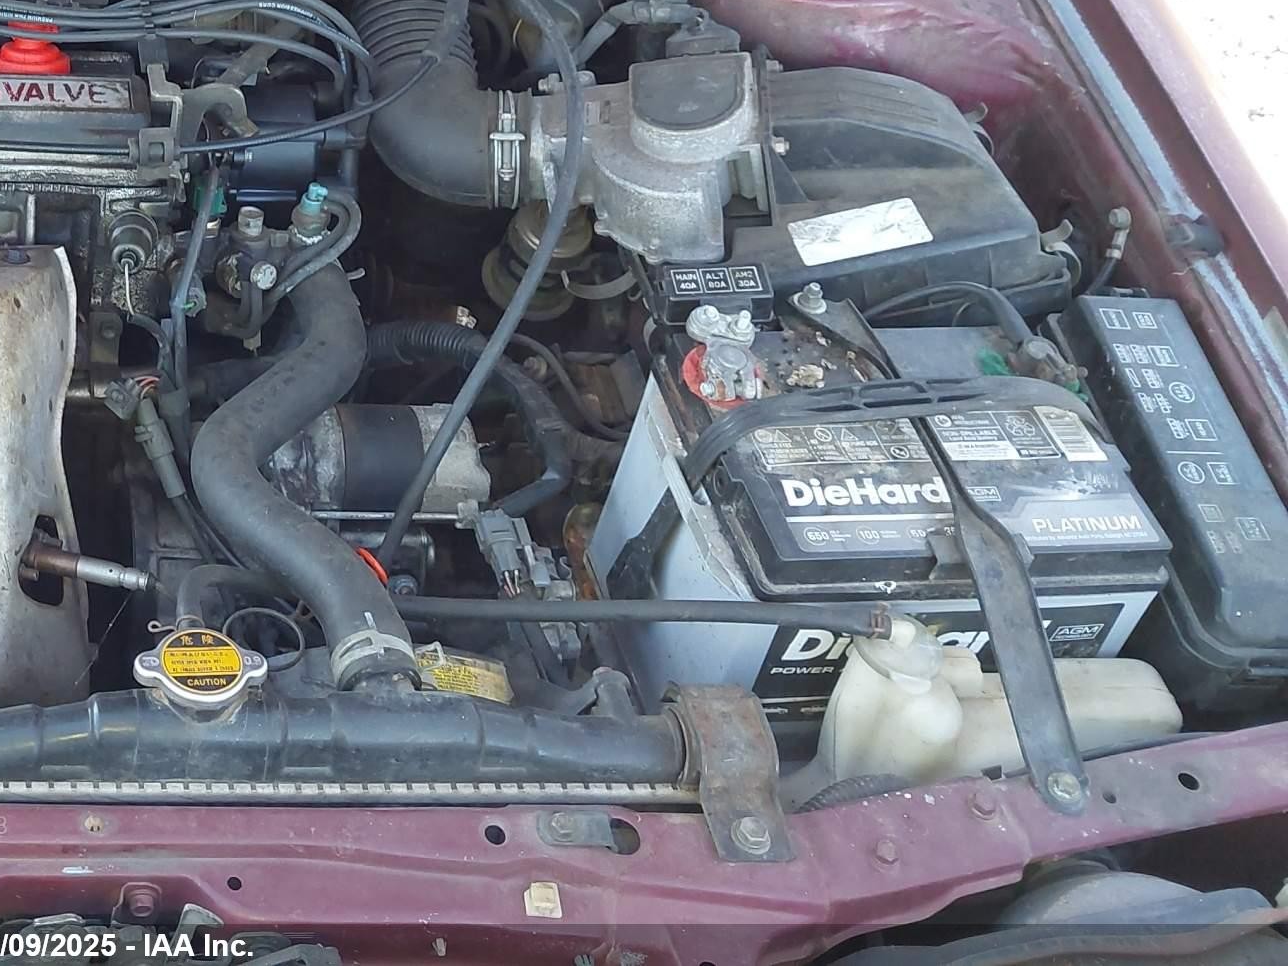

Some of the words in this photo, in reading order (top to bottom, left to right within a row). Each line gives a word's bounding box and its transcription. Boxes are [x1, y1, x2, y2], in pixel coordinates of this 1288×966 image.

[675, 273, 697, 281] MAIN
[705, 272, 724, 280] ALT
[679, 281, 697, 290] 40A
[738, 279, 756, 287] 30A
[779, 475, 952, 507] DieHard
[1031, 515, 1142, 533] PLATINUM
[859, 530, 880, 540] 100
[1057, 626, 1100, 635] AGM
[770, 666, 833, 675] POWER
[187, 677, 227, 687] CAUTION
